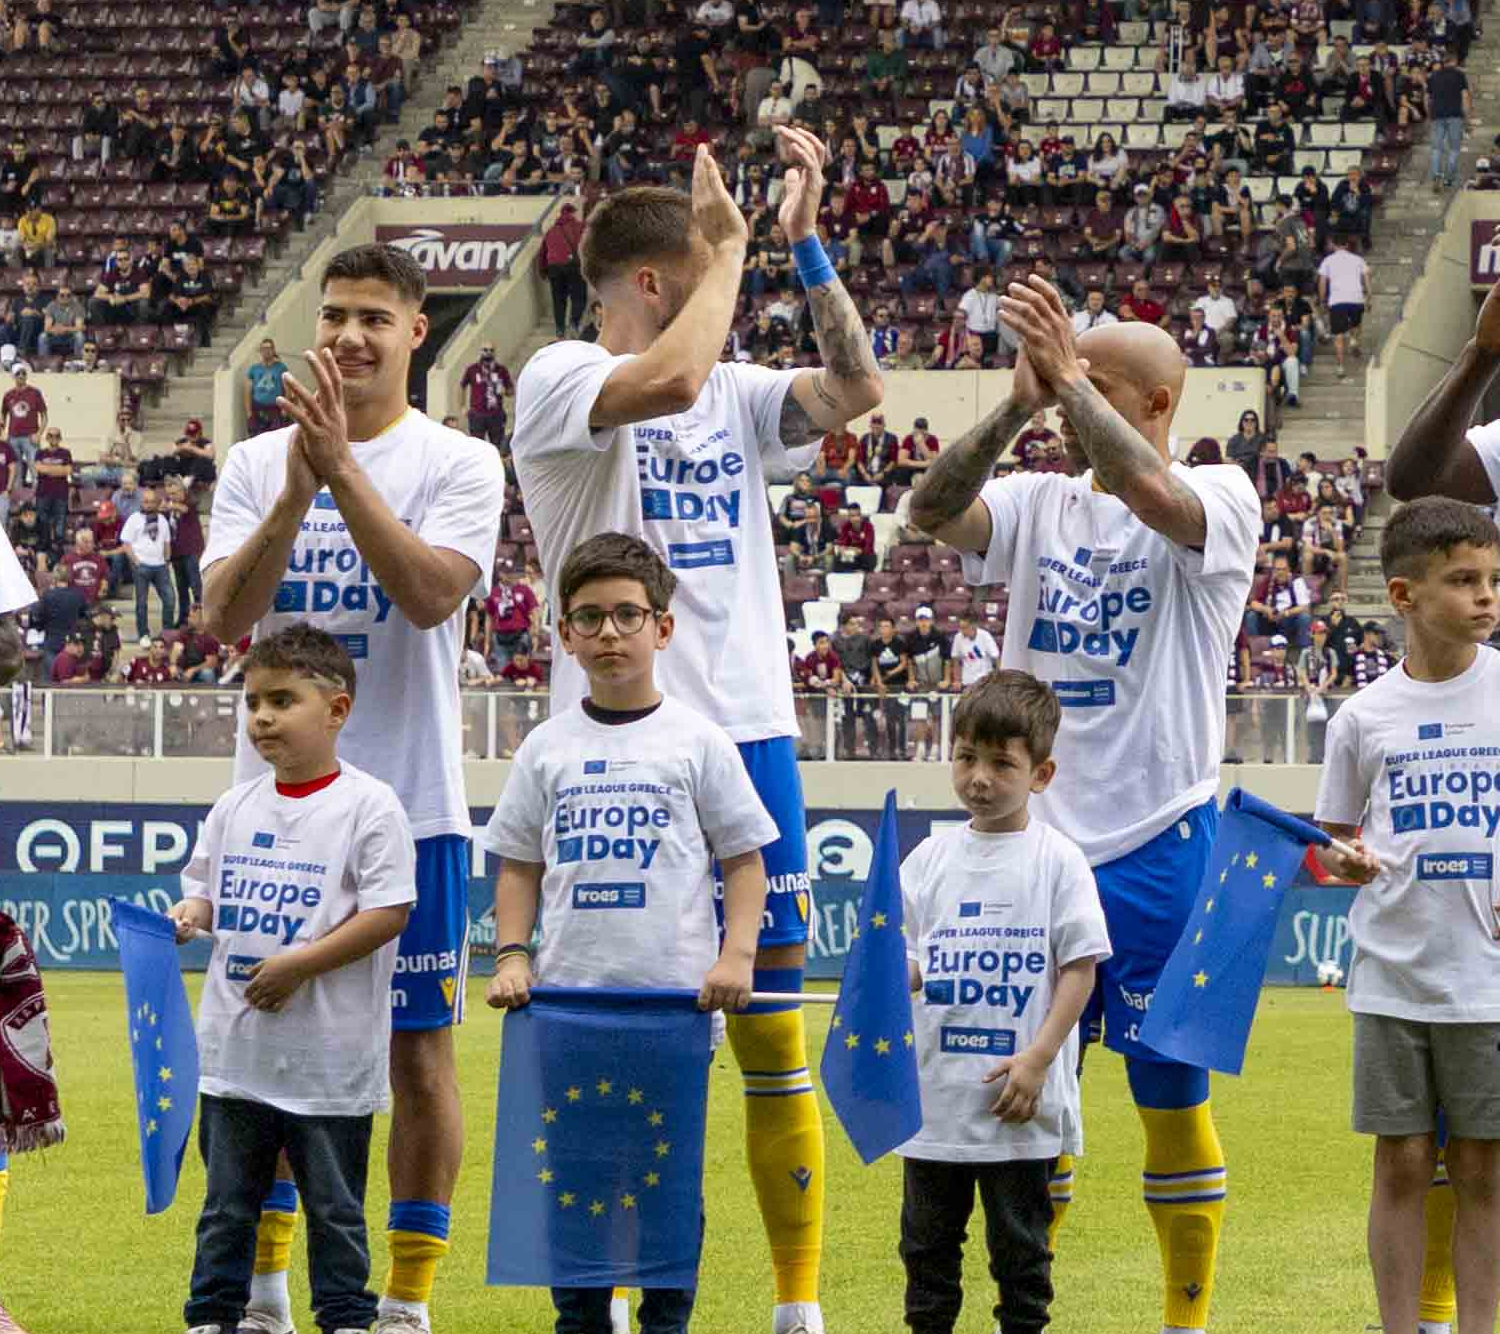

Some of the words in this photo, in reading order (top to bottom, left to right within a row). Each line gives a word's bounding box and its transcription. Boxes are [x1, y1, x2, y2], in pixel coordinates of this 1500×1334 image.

[1057, 620, 1141, 667] Day
[1385, 752, 1421, 766] SUPER
[1422, 747, 1469, 761] LEAGUE
[584, 783, 627, 796] LEAGUE
[555, 802, 671, 837] Europe
[586, 834, 661, 869] Day
[219, 869, 321, 912] Europe
[238, 905, 307, 947] Day
[959, 927, 1000, 938] LEAGUE
[927, 944, 1046, 983] Europe
[958, 978, 1035, 1018] Day
